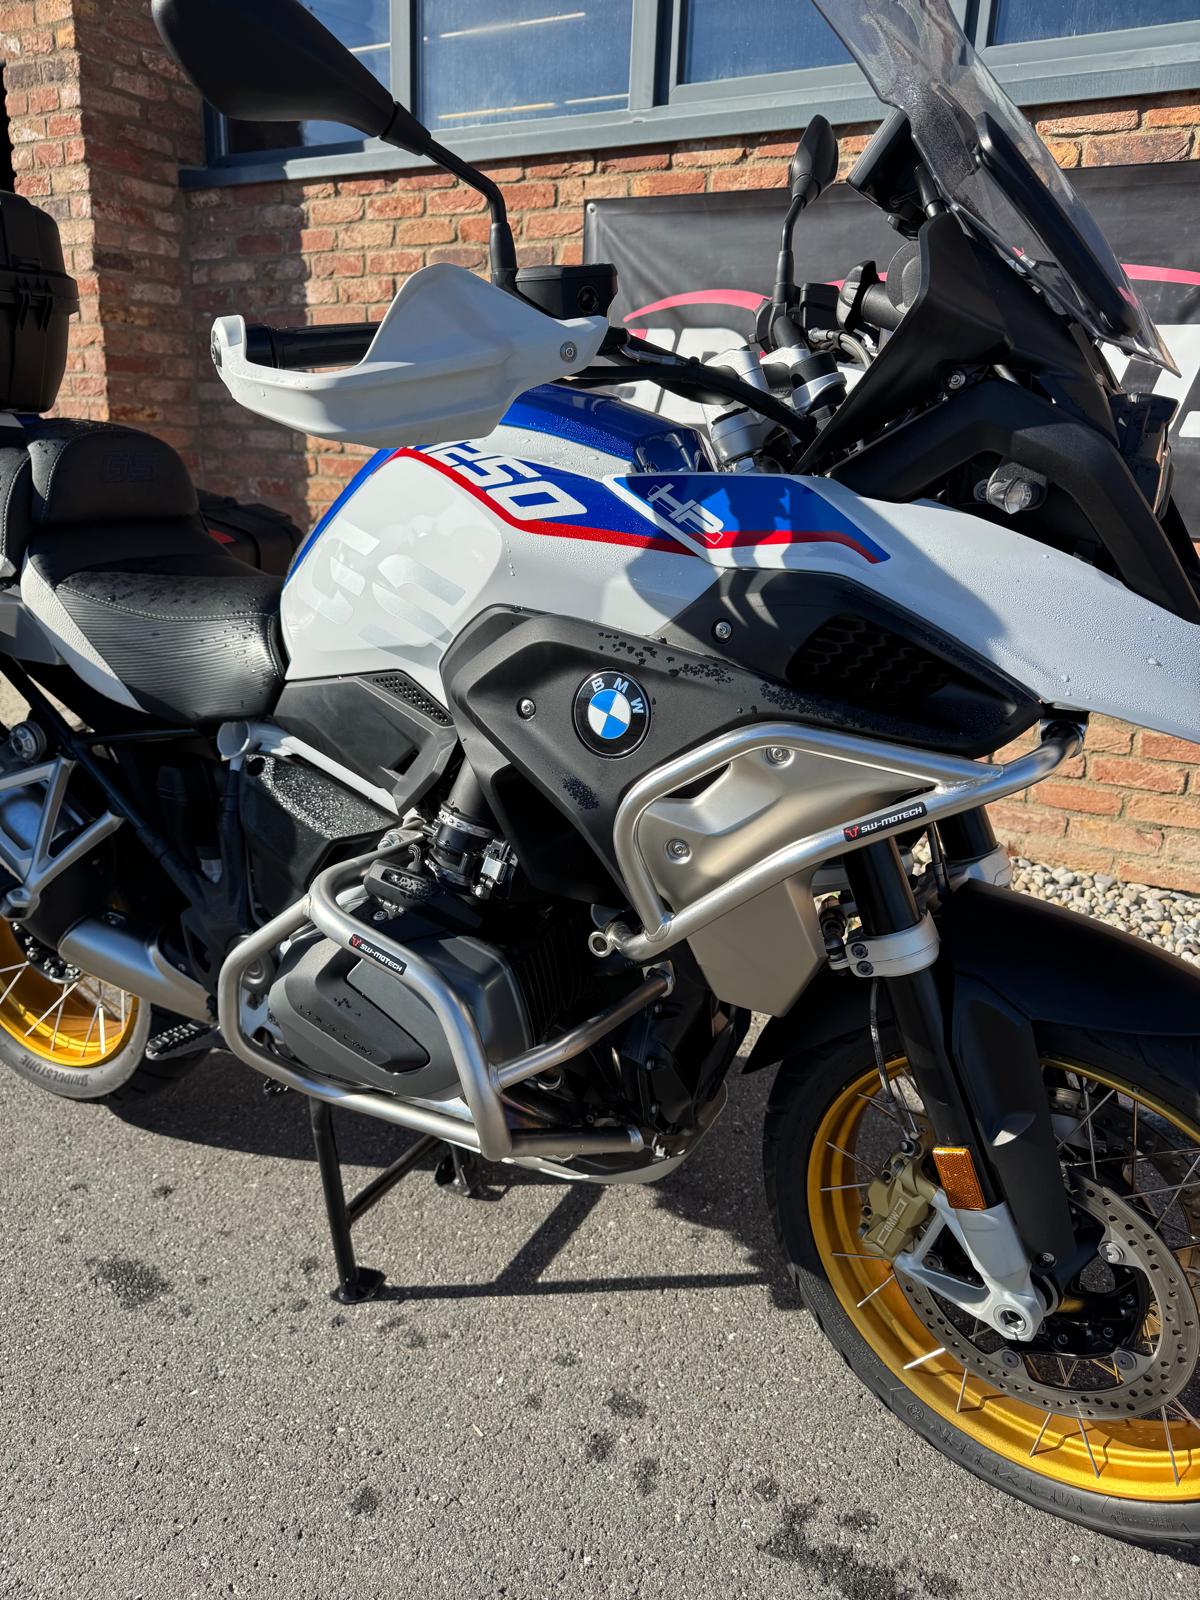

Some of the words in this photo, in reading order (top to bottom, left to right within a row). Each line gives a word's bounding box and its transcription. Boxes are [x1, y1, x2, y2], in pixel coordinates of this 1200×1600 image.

[591, 677, 644, 714] BMW
[861, 806, 923, 834] SW-MOTECH
[360, 943, 403, 972] SW-MOTECH
[21, 1054, 89, 1087] BRIDGESTONE
